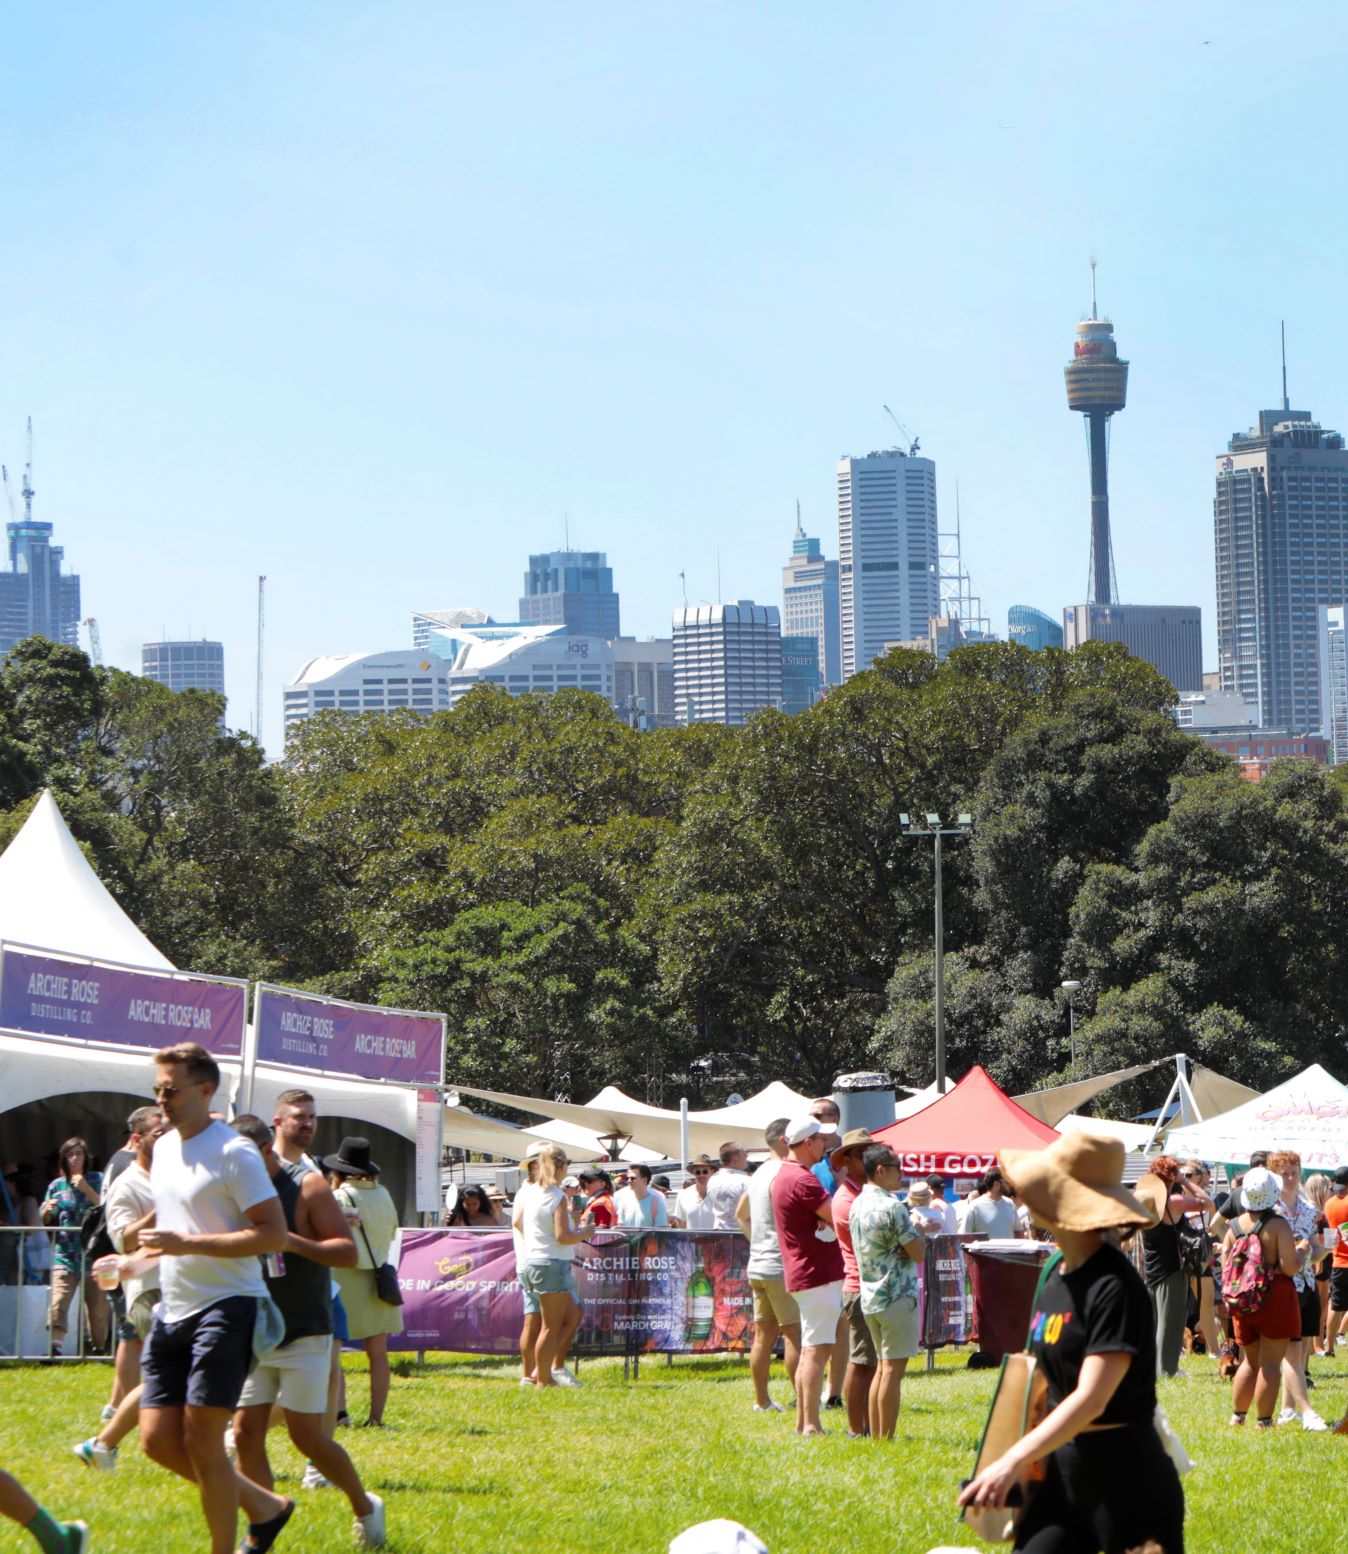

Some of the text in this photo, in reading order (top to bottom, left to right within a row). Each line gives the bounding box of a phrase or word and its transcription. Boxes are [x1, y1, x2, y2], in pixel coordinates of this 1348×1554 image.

[568, 640, 588, 658] iag
[27, 972, 100, 1004] ARCHIE ROSE
[31, 1003, 78, 1022] DISTILLING
[128, 998, 212, 1030] ARCHIE ROSE BAR
[280, 1012, 335, 1040] ARCHIE ROSE
[282, 1037, 317, 1055] DISTILLING
[354, 1034, 417, 1060] ARCHIE ROSE BAR
[944, 1154, 1001, 1174] GOZ
[582, 1256, 676, 1270] ARCHIE ROSE
[587, 1272, 652, 1281] DISTILLING
[416, 1280, 431, 1291] IN
[434, 1280, 476, 1292] GOOD
[723, 1297, 743, 1305] MADE
[614, 1321, 675, 1331] MARDI GRAS
